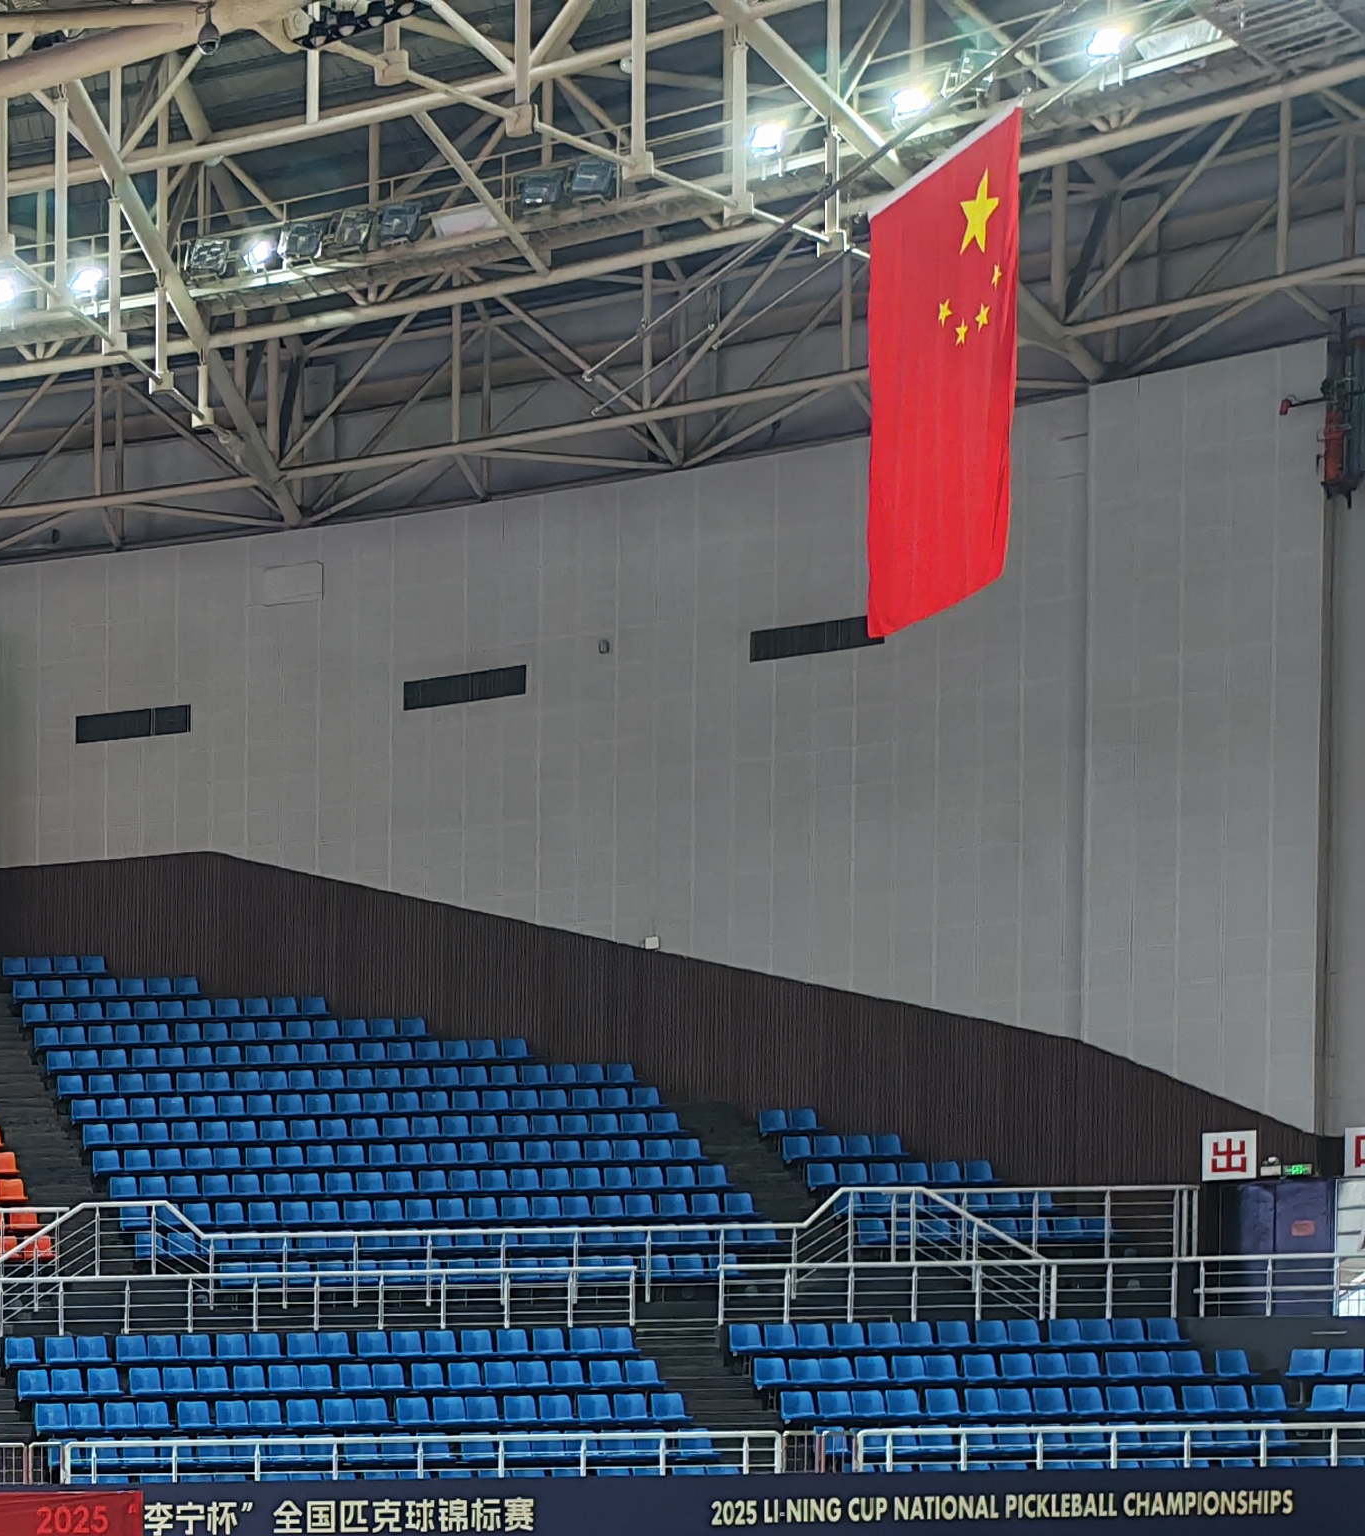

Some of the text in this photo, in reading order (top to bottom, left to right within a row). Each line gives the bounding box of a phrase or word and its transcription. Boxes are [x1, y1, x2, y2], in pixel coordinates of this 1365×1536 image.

[711, 1489, 1295, 1526] 2025 LI-NING CUP NATIONAL PICKLEBALL CHAMPIONSHIPS
